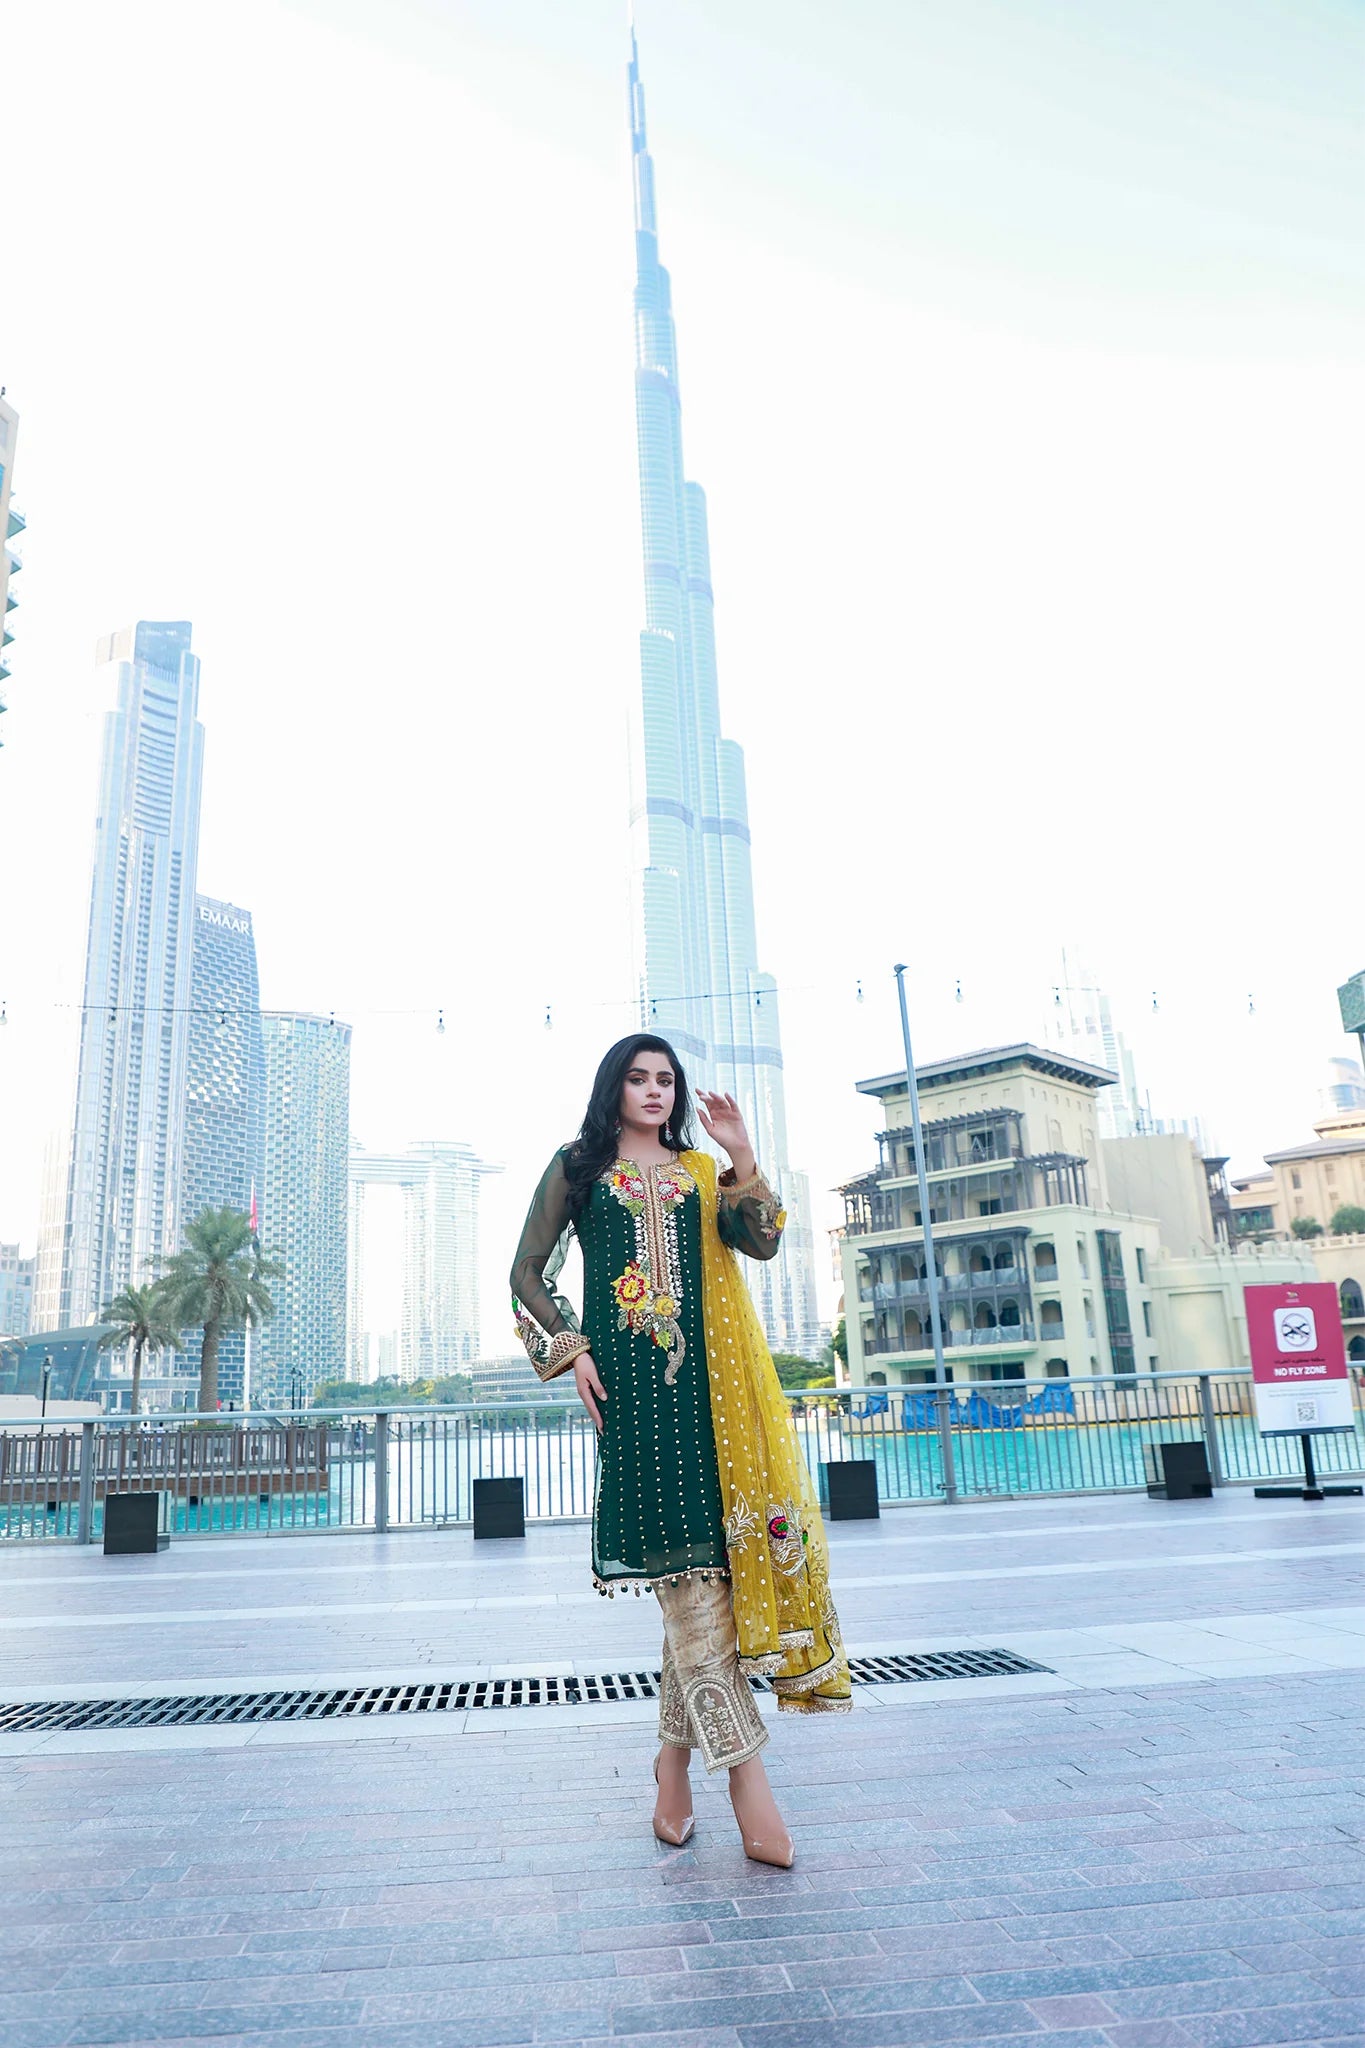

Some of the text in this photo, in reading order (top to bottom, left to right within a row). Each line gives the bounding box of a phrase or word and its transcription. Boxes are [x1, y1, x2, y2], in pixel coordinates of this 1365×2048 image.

[200, 907, 250, 936] EMAAR
[1274, 1366, 1327, 1377] NO FLY ZONE
